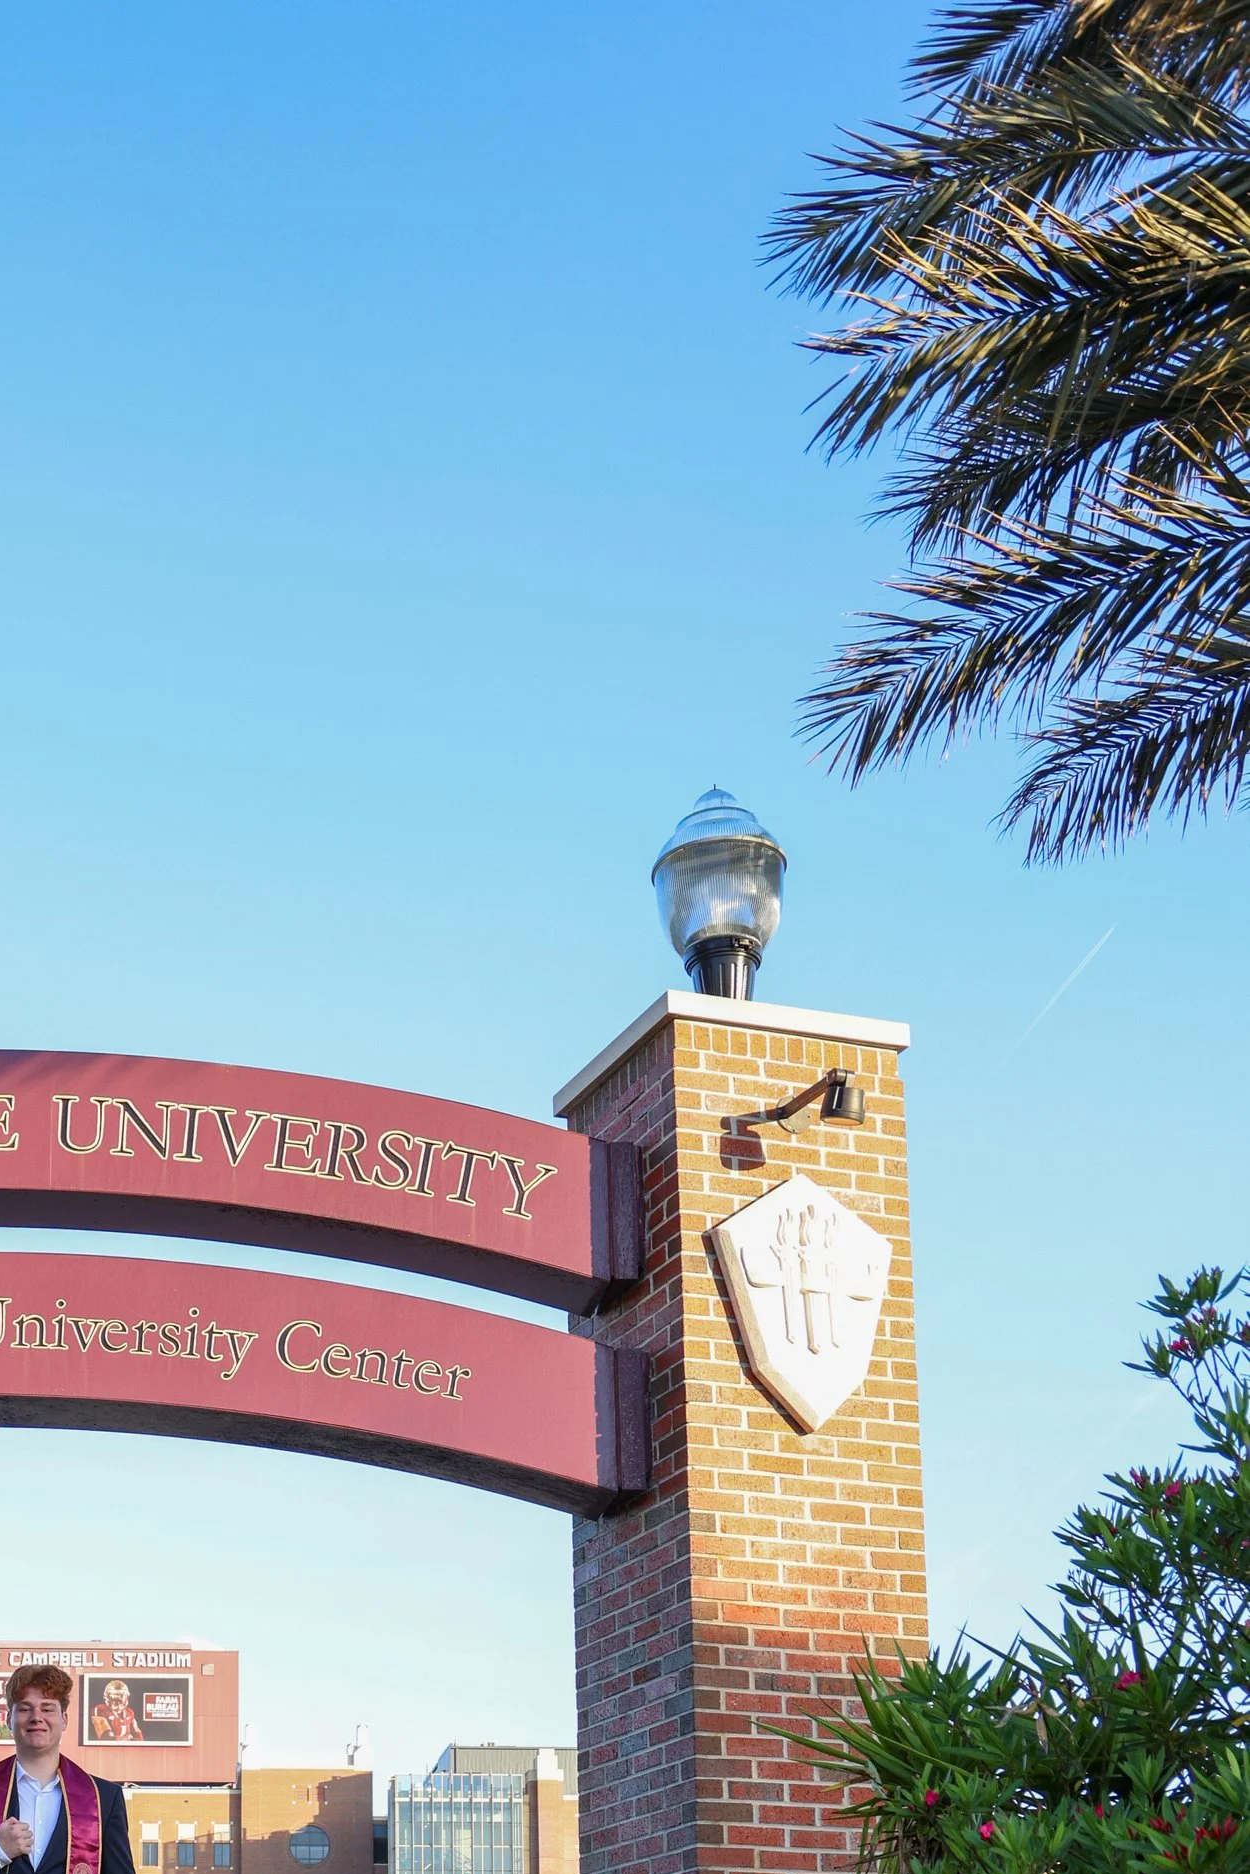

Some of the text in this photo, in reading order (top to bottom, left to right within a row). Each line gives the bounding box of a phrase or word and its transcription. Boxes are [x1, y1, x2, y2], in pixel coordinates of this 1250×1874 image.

[53, 1095, 558, 1221] UNIVERSITY
[275, 1320, 473, 1402] Center
[9, 1651, 104, 1668] CAMPBELL
[112, 1652, 192, 1668] STADIUM
[146, 1703, 179, 1711] BUREAU
[155, 1696, 179, 1704] FARM
